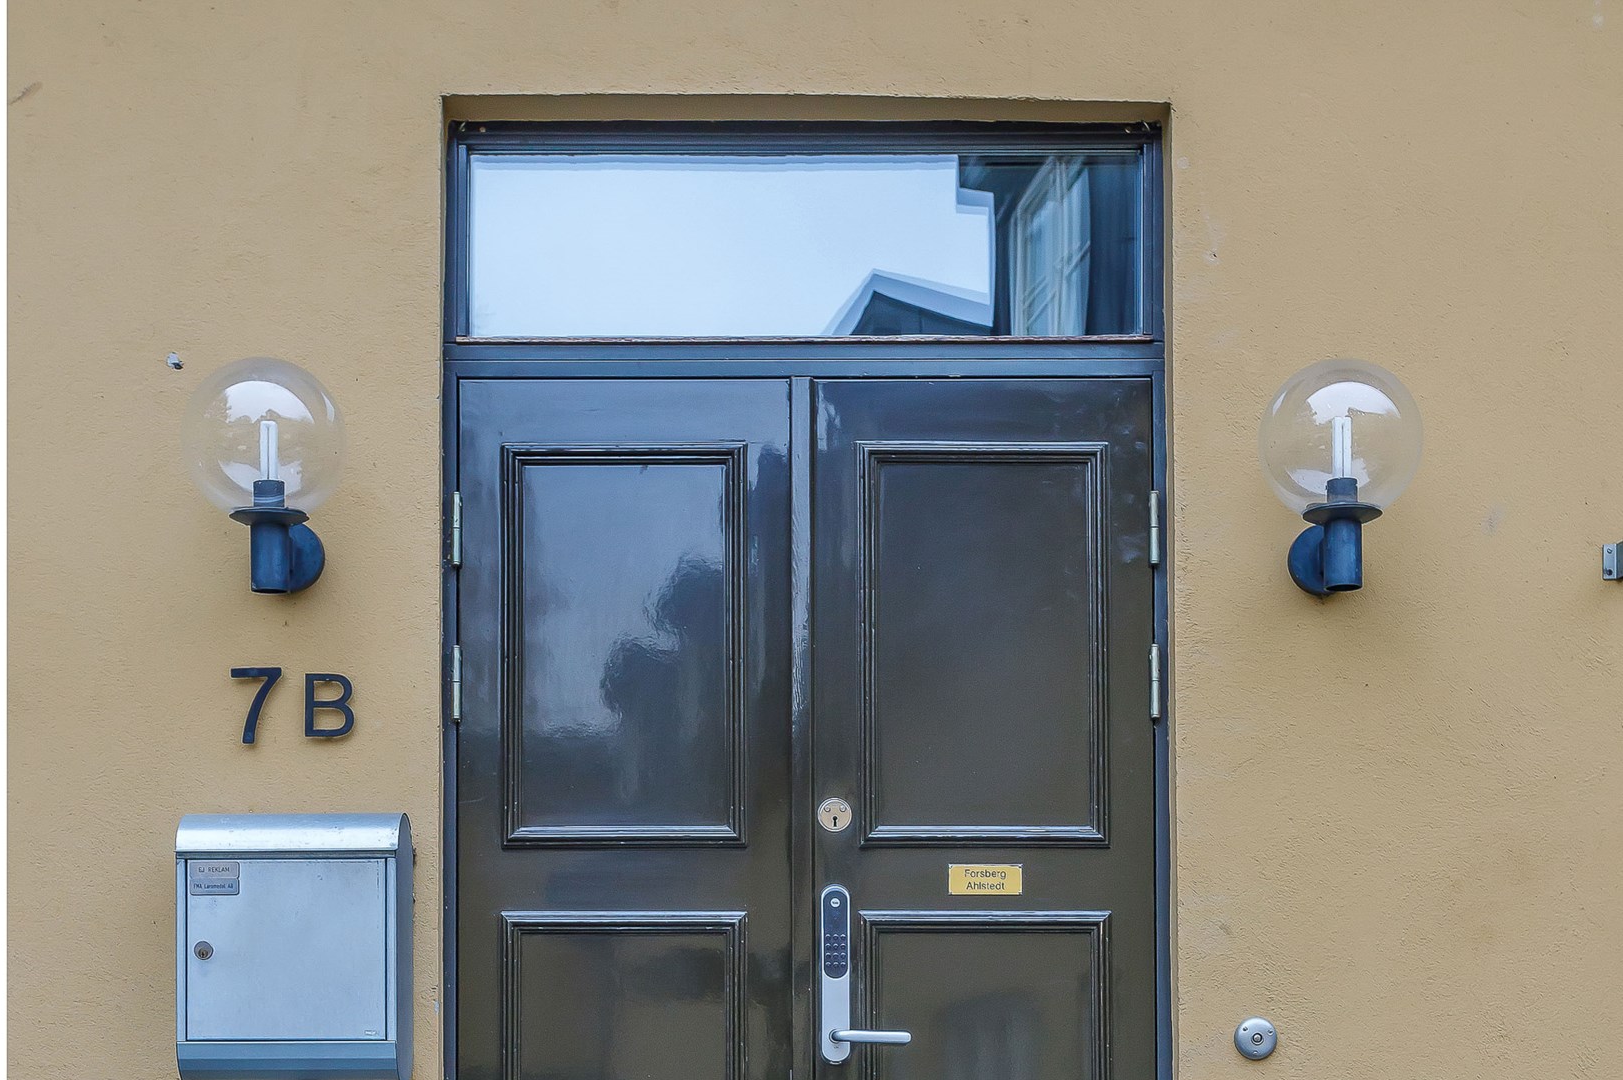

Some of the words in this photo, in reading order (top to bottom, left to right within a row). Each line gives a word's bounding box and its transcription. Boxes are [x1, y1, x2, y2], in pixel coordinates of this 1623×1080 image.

[229, 666, 283, 745] 7
[304, 672, 356, 739] B
[964, 869, 1007, 880] Forsberg
[966, 881, 1006, 890] Ahlstedt
